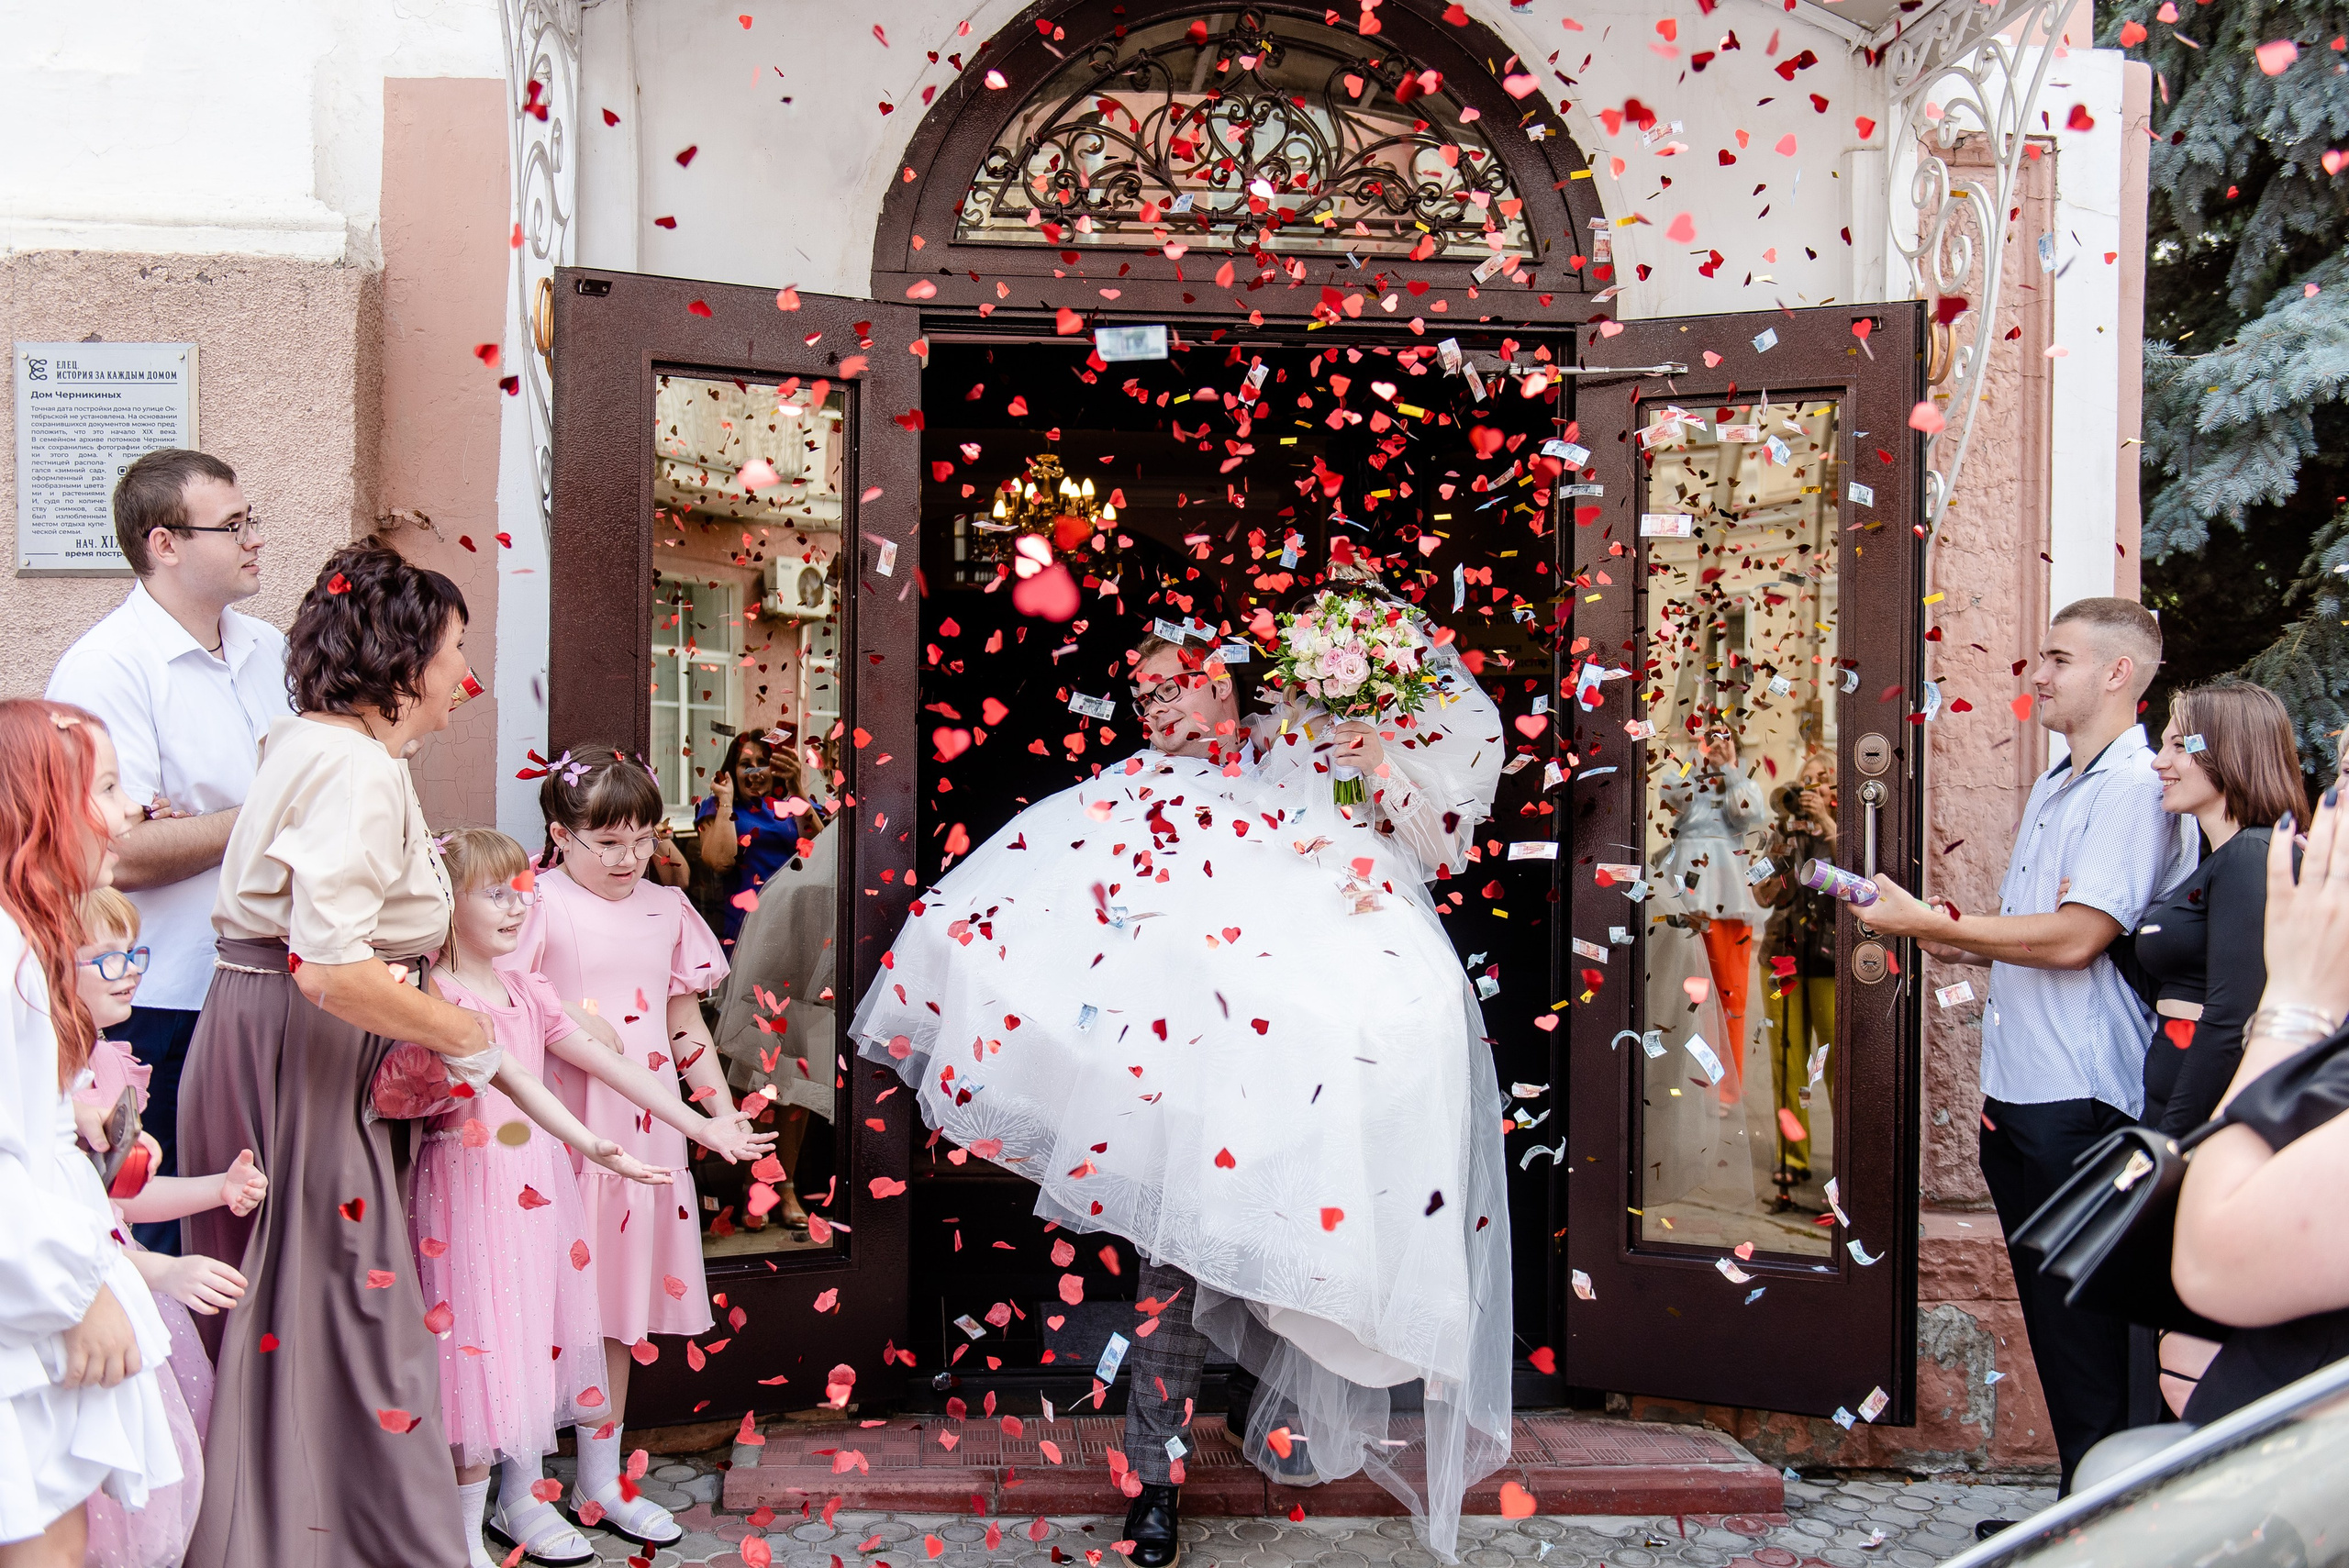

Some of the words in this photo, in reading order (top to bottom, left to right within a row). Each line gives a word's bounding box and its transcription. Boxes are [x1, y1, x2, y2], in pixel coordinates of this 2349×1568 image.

[56, 360, 79, 370] ЕЛЕЦ.
[57, 371, 93, 379] ИСТОРИЯ
[95, 371, 105, 379] ЗА
[107, 371, 145, 380] КАЖДЫМ
[146, 371, 177, 380] ДОМОМ
[31, 391, 52, 399] Дом
[55, 391, 121, 400] Черникиных
